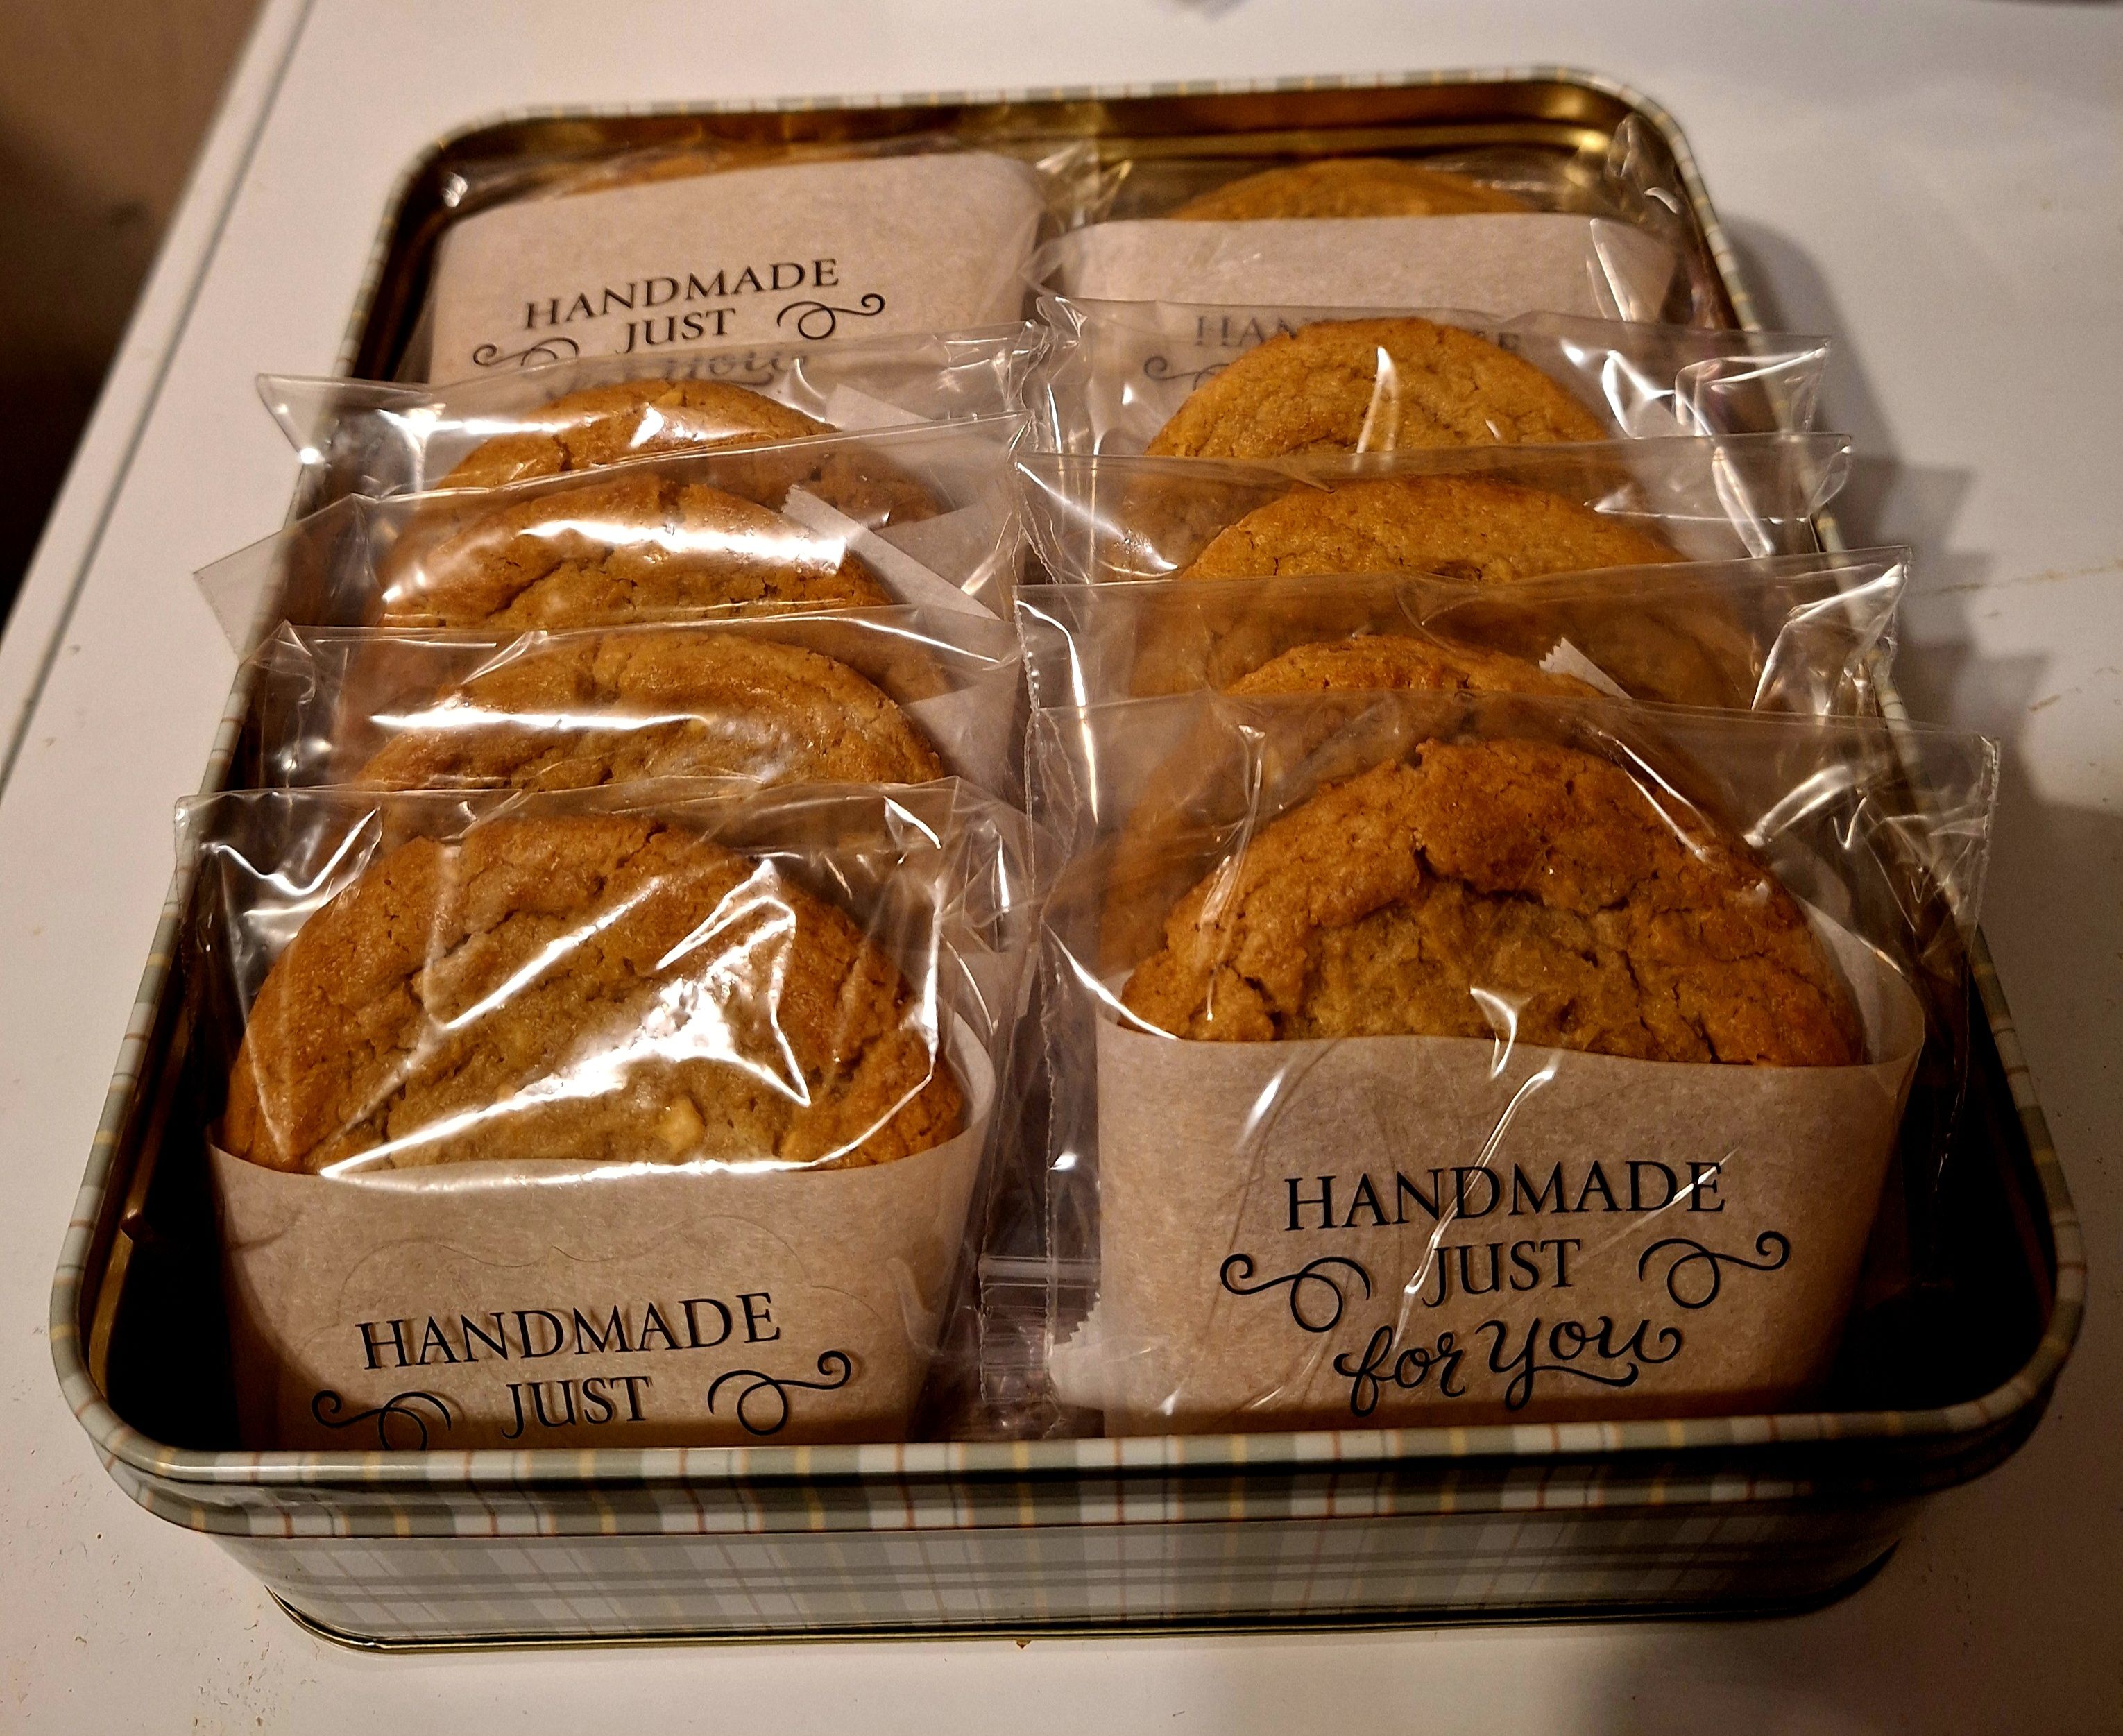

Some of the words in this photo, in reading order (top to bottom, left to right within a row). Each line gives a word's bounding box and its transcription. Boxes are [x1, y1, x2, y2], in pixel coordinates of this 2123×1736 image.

[525, 258, 839, 330] HANDMADE
[615, 307, 736, 354] JUST
[1284, 1161, 1725, 1231] HANDMADE
[1422, 1239, 1581, 1307] JUST
[355, 1292, 781, 1370] HANDMADE
[1333, 1326, 1465, 1417] for
[503, 1375, 650, 1440] JUST
